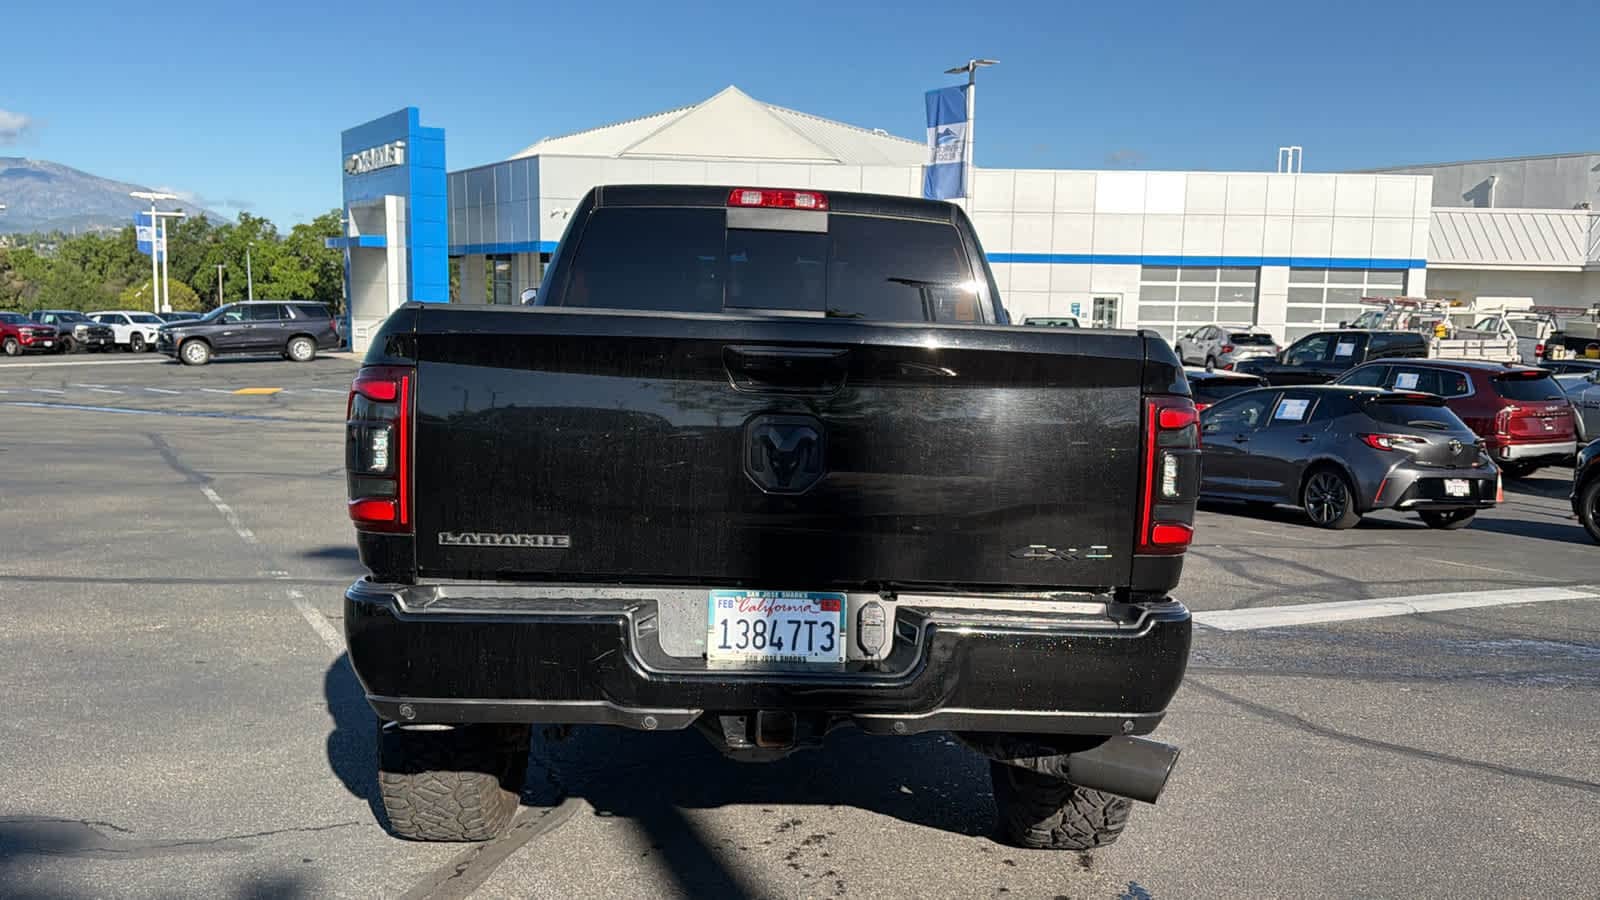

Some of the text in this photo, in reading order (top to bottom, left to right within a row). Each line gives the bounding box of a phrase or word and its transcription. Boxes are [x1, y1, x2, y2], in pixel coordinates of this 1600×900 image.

[438, 531, 570, 548] LARAMIE
[718, 599, 734, 609] FEB
[736, 598, 820, 617] California
[718, 619, 835, 652] 13847T3
